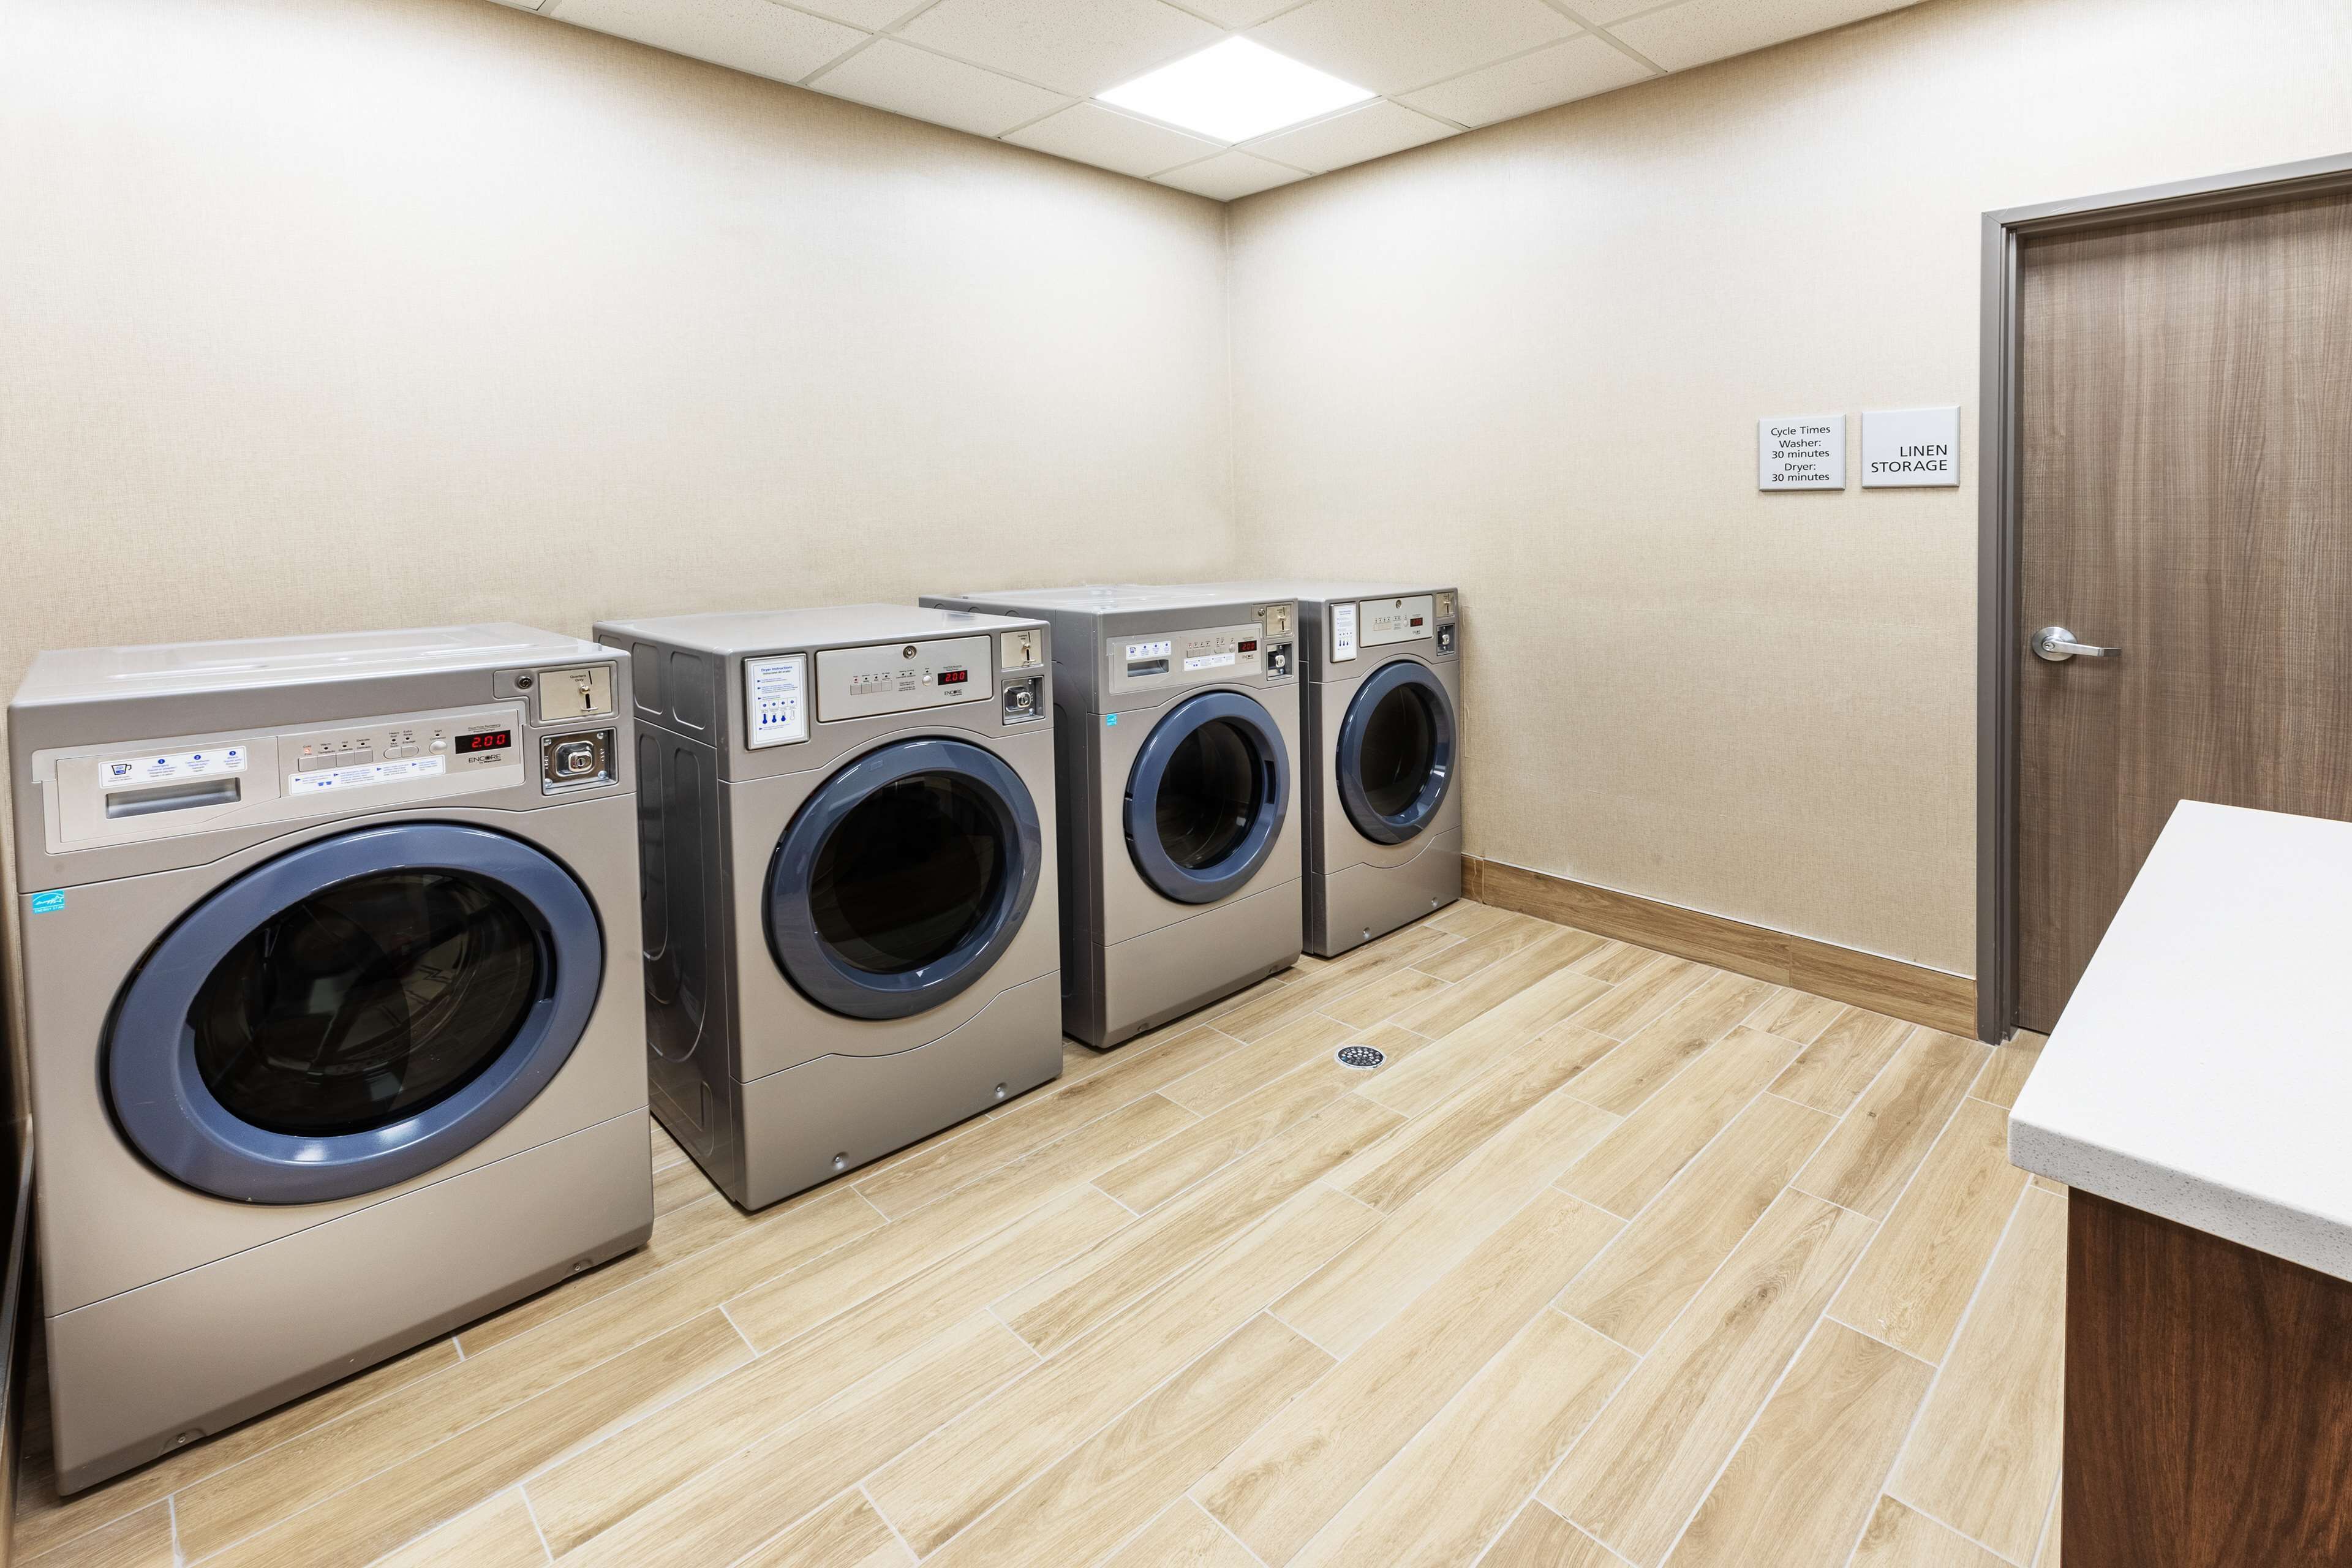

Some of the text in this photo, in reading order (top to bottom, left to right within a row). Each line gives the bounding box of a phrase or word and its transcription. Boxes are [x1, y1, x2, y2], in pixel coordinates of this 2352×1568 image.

[1771, 426, 1831, 437] Cycle Times
[1779, 439, 1821, 448] Washer:
[1900, 445, 1947, 457] LINEN
[1784, 463, 1816, 472] Dryer:
[1871, 459, 1948, 473] STORAGE
[1788, 473, 1830, 481] minutes
[945, 672, 965, 682] 2.00
[472, 734, 505, 748] 2.00
[468, 754, 501, 763] ENCORE
